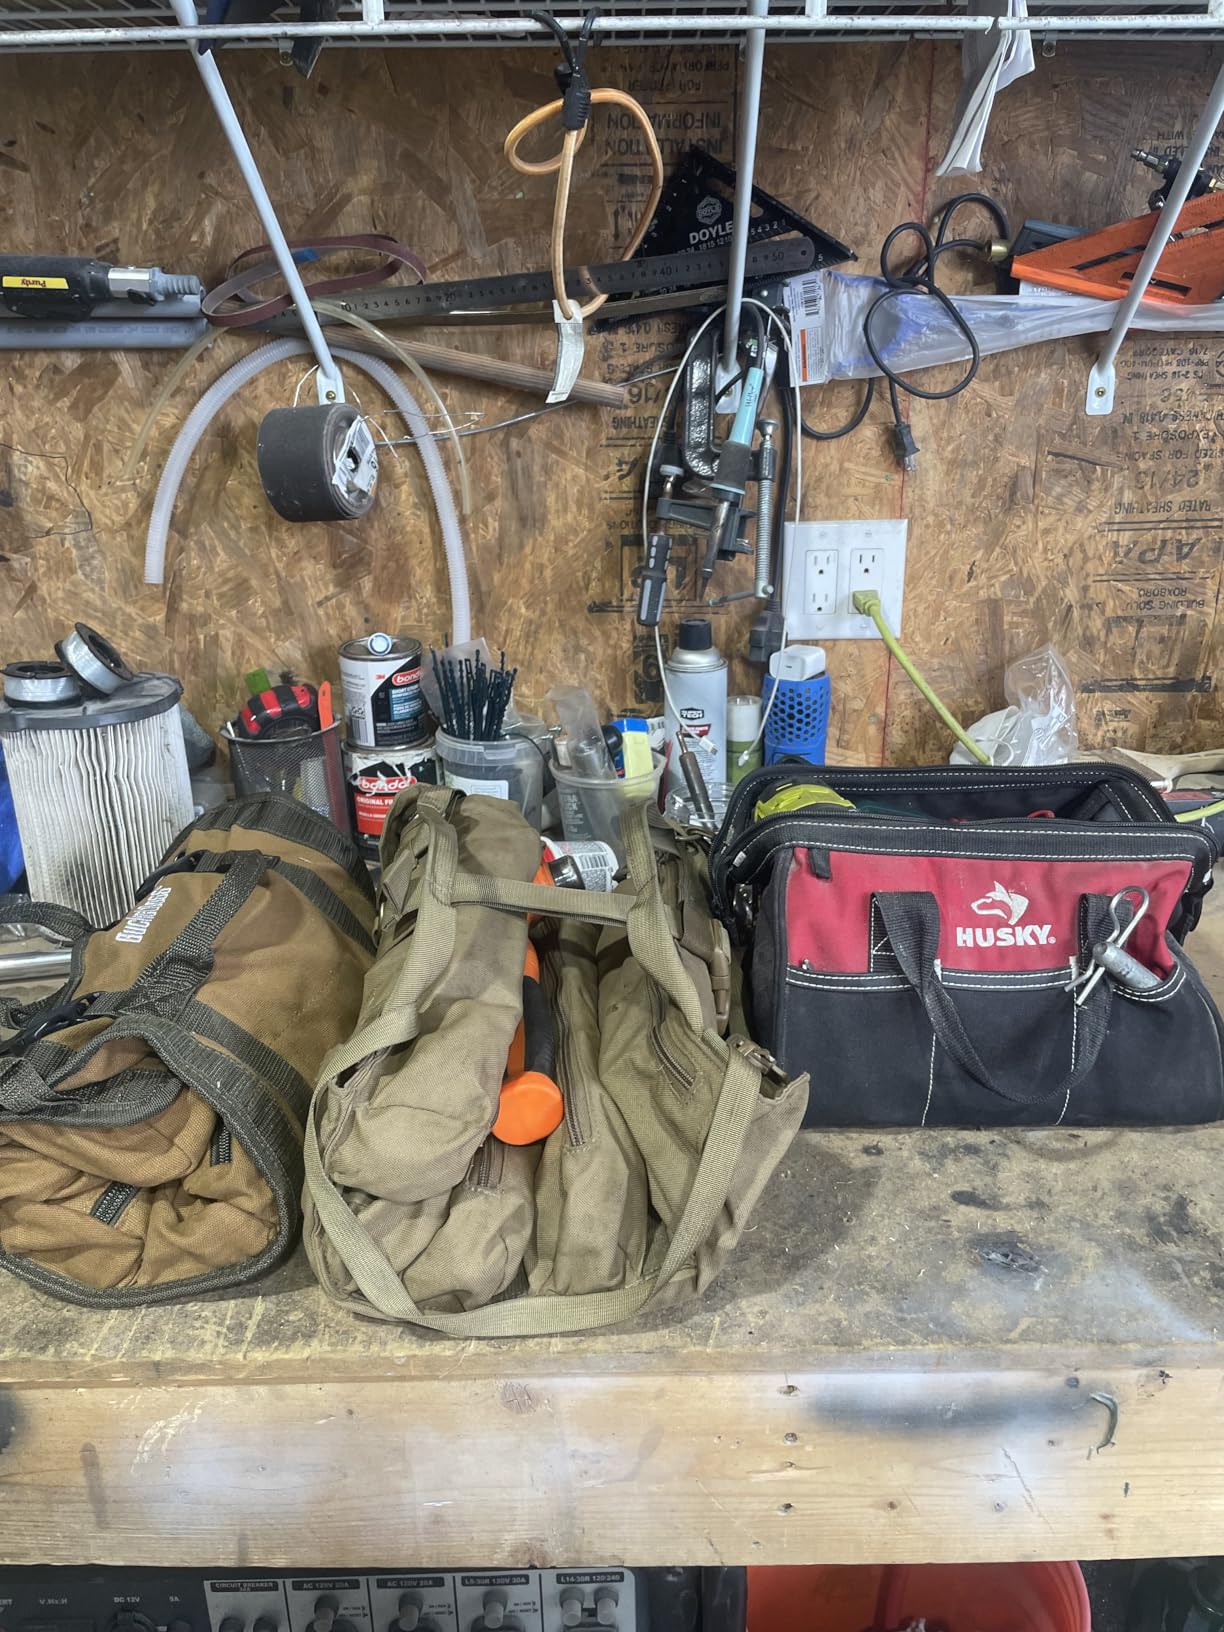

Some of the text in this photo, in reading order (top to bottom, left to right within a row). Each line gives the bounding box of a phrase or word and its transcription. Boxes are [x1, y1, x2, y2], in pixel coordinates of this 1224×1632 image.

[689, 221, 734, 246] DOYLE
[20, 278, 46, 288] Purdy
[1114, 500, 1212, 514] RATED SHEATHING
[1159, 599, 1206, 610] BUILDING
